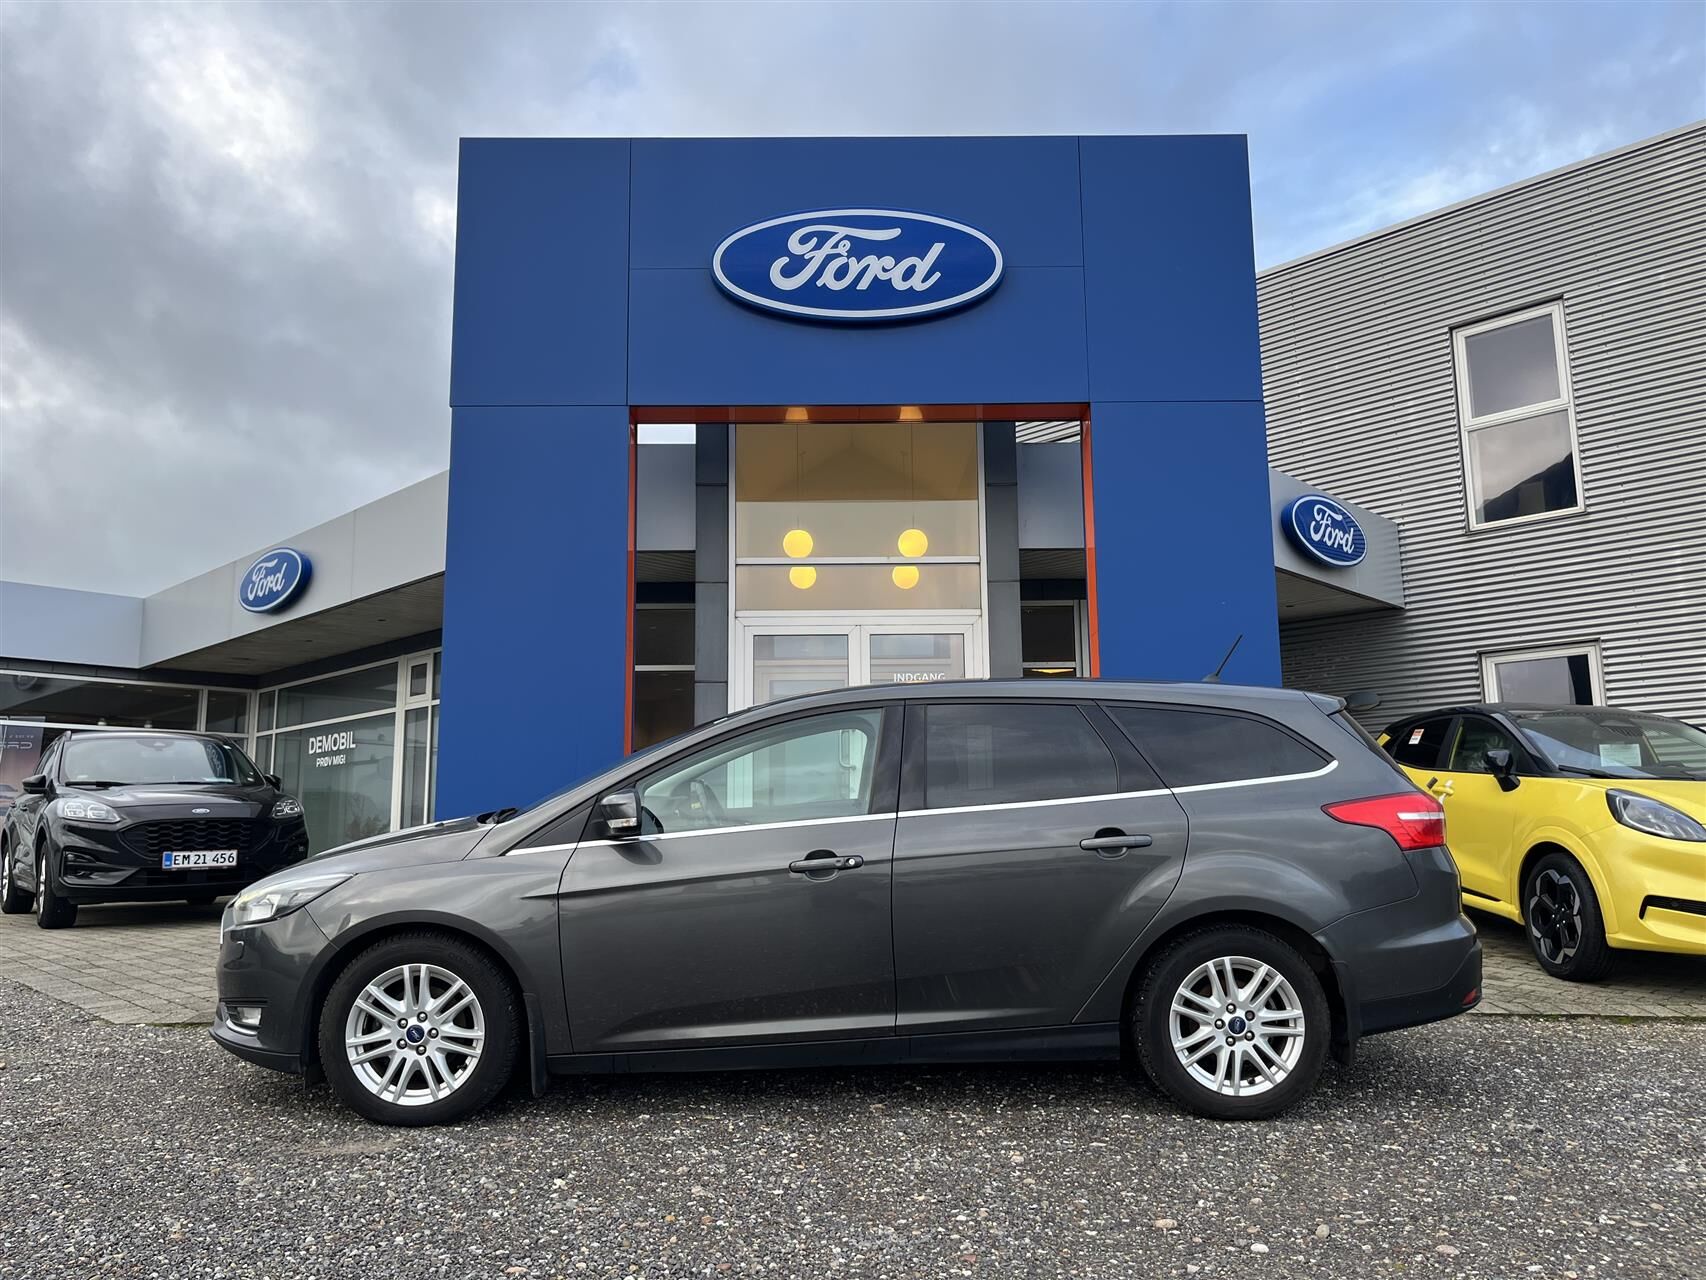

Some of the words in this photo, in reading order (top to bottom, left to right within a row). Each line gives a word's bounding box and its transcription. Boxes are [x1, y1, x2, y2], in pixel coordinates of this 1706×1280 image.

[769, 224, 945, 292] Ford
[1310, 504, 1355, 554] Ford
[247, 558, 288, 601] Ford
[893, 672, 945, 683] INDGANG
[308, 731, 356, 755] DEMOBIL
[173, 854, 191, 866] EM
[193, 854, 208, 865] 21
[212, 852, 236, 865] 456
